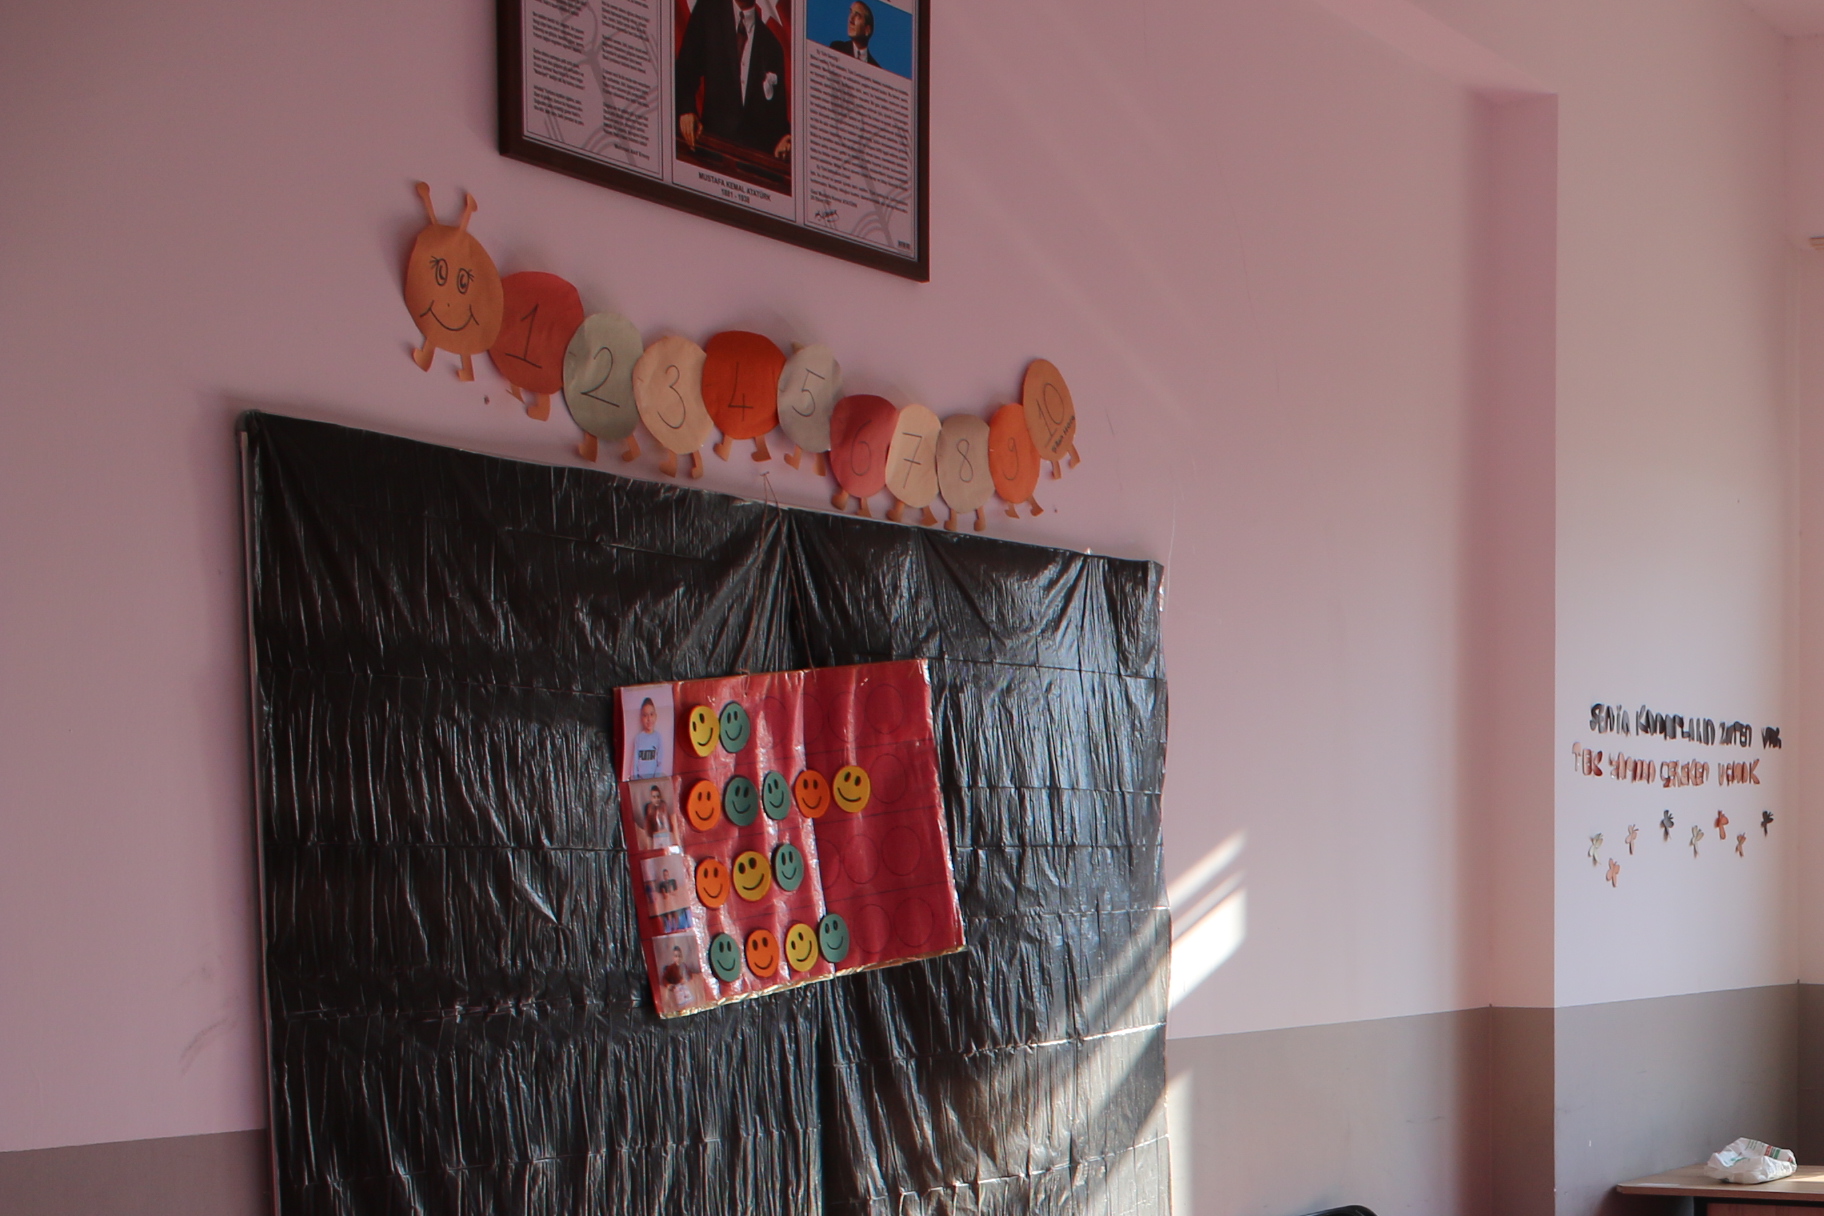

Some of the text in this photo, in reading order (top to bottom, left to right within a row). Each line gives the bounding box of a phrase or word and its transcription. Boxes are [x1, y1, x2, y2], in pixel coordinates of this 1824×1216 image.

[698, 171, 726, 187] MUSTAFA
[726, 181, 746, 194] KEMAL
[504, 303, 543, 369] 1
[580, 346, 621, 408] 2
[663, 363, 687, 430] 3
[727, 360, 754, 422] 4
[796, 366, 826, 418] 5
[1036, 382, 1065, 448] 10
[849, 421, 875, 477] 6
[901, 431, 924, 490] 7
[957, 437, 975, 484] 8
[1005, 433, 1020, 482] 9
